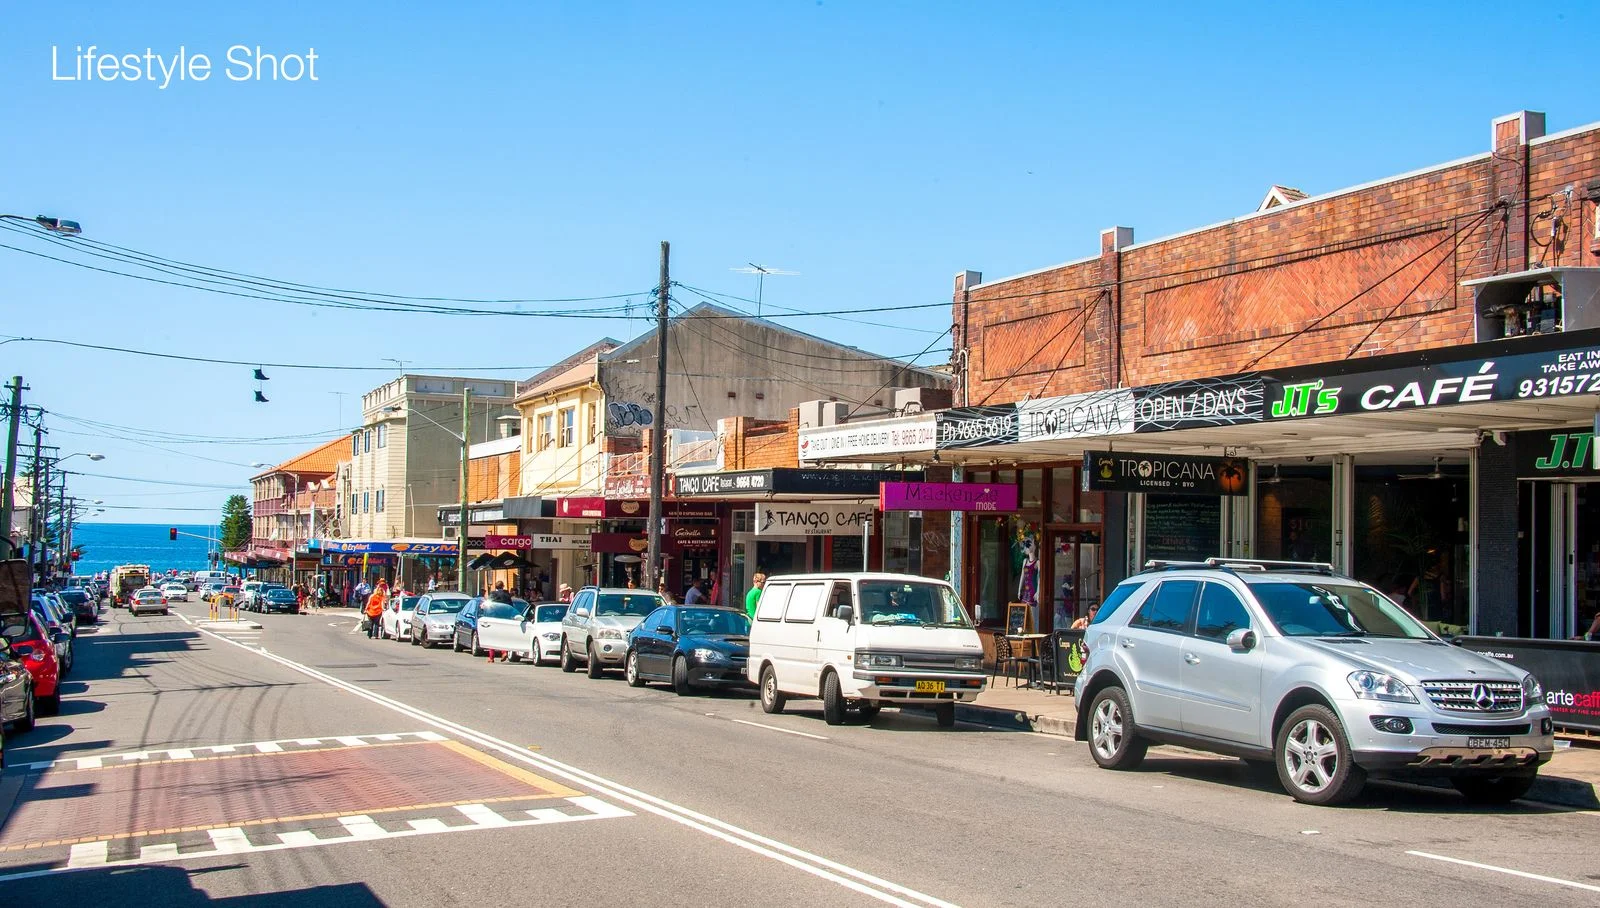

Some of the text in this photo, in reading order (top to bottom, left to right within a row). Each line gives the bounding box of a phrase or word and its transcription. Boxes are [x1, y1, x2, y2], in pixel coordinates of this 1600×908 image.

[1558, 350, 1600, 363] EAT IN
[1541, 362, 1576, 373] TAKE
[1271, 361, 1499, 417] J.T's CAFÉ
[1518, 373, 1600, 398] 931572
[1140, 388, 1246, 422] OPEN 7 DAYS
[1029, 402, 1122, 436] TROPICANA
[847, 434, 858, 447] FREE
[1120, 459, 1215, 480] TROPICANA
[906, 483, 998, 502] Mackenzie
[776, 507, 873, 529] TANGO CAFÉ
[500, 537, 532, 548] cargo
[540, 536, 562, 544] THAI
